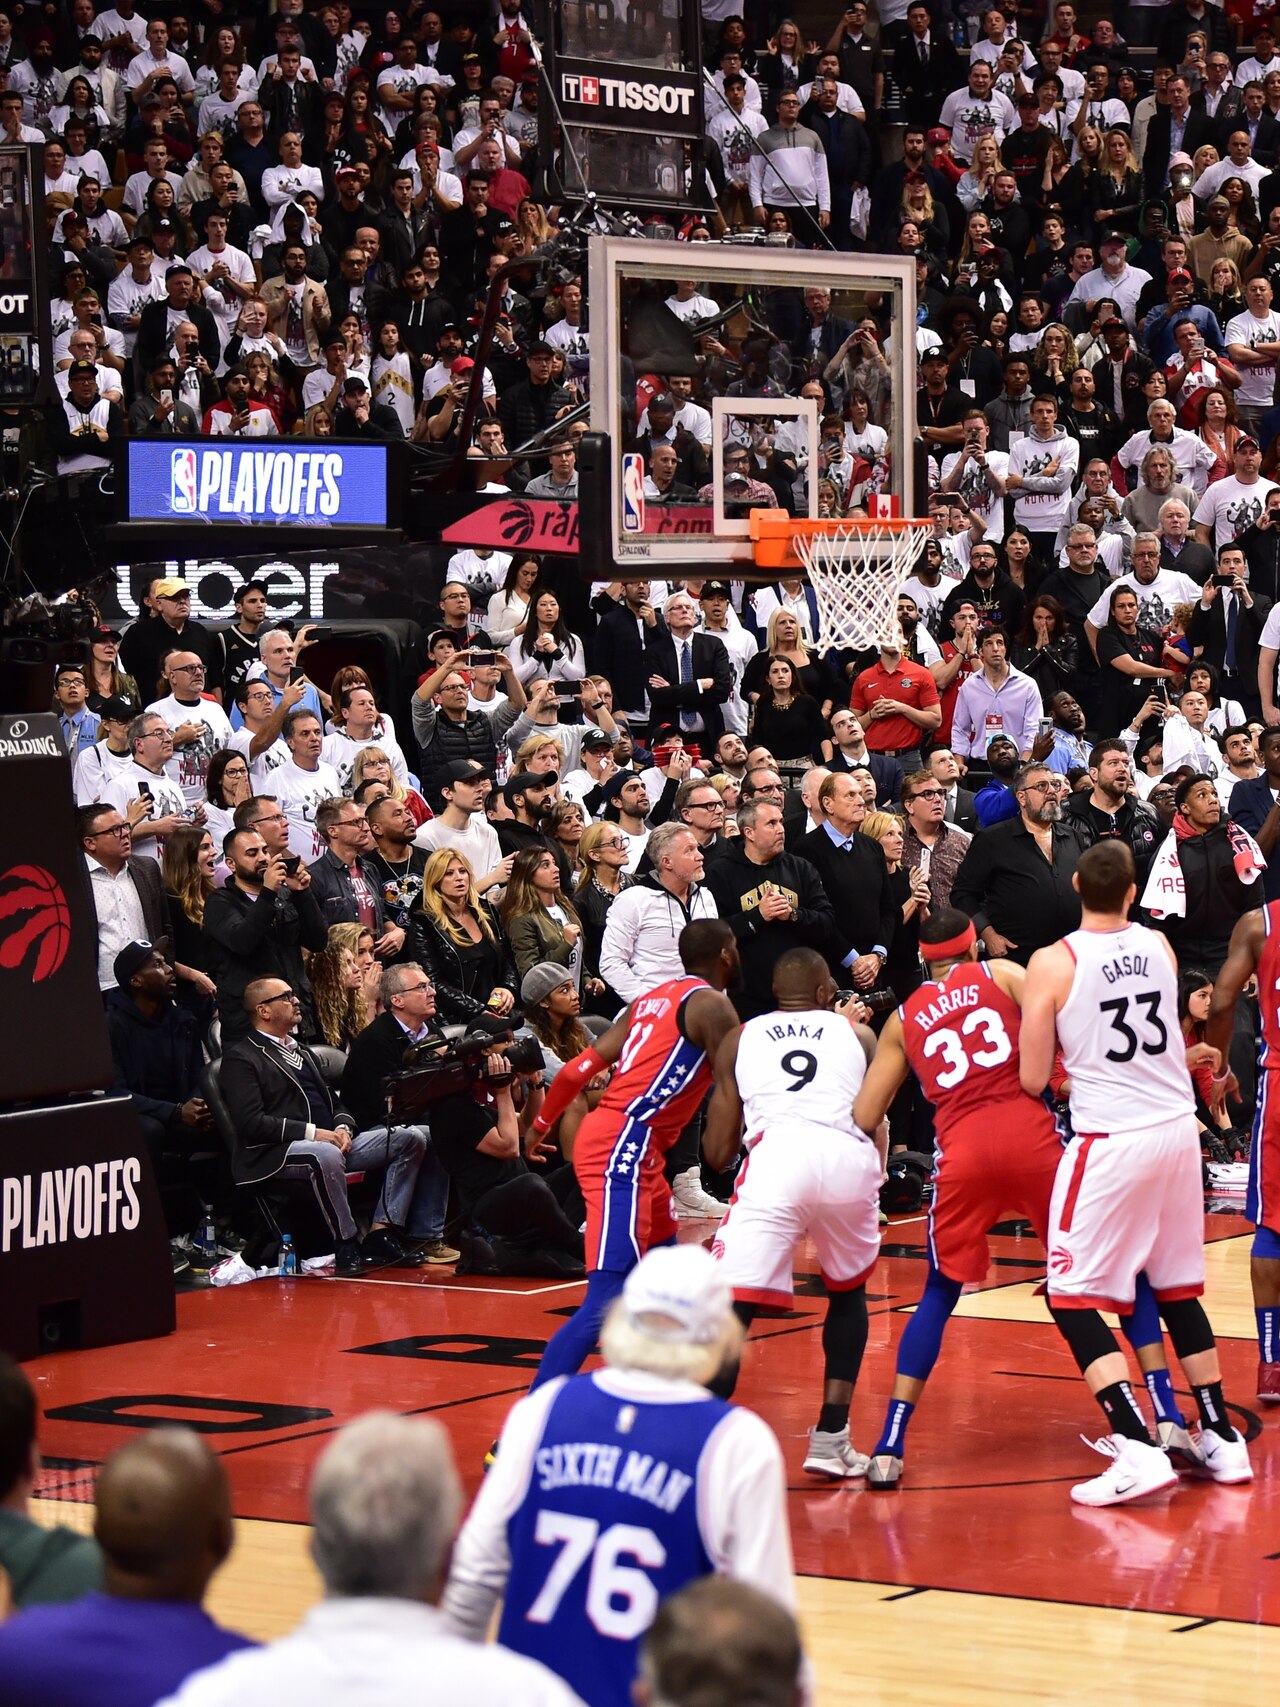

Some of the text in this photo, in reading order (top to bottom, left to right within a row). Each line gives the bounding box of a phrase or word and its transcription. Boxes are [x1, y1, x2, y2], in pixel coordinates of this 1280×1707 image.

[602, 83, 695, 116] TISSOT
[0, 294, 29, 315] OT
[387, 392, 396, 406] 2
[200, 451, 342, 517] PLAYOFFS
[1024, 494, 1060, 505] NORTH
[618, 545, 650, 557] SPALDING
[0, 735, 59, 758] PALDING
[1101, 956, 1149, 985] GASOL
[914, 984, 980, 1030] HARRIS
[767, 1025, 825, 1042] IBAKA
[1100, 990, 1168, 1063] 33
[923, 1006, 1012, 1089] 33
[781, 1049, 818, 1092] 9
[3, 1157, 141, 1251] PLAYOFFS
[536, 1445, 694, 1515] SIXTH MAN
[526, 1509, 667, 1641] 76
